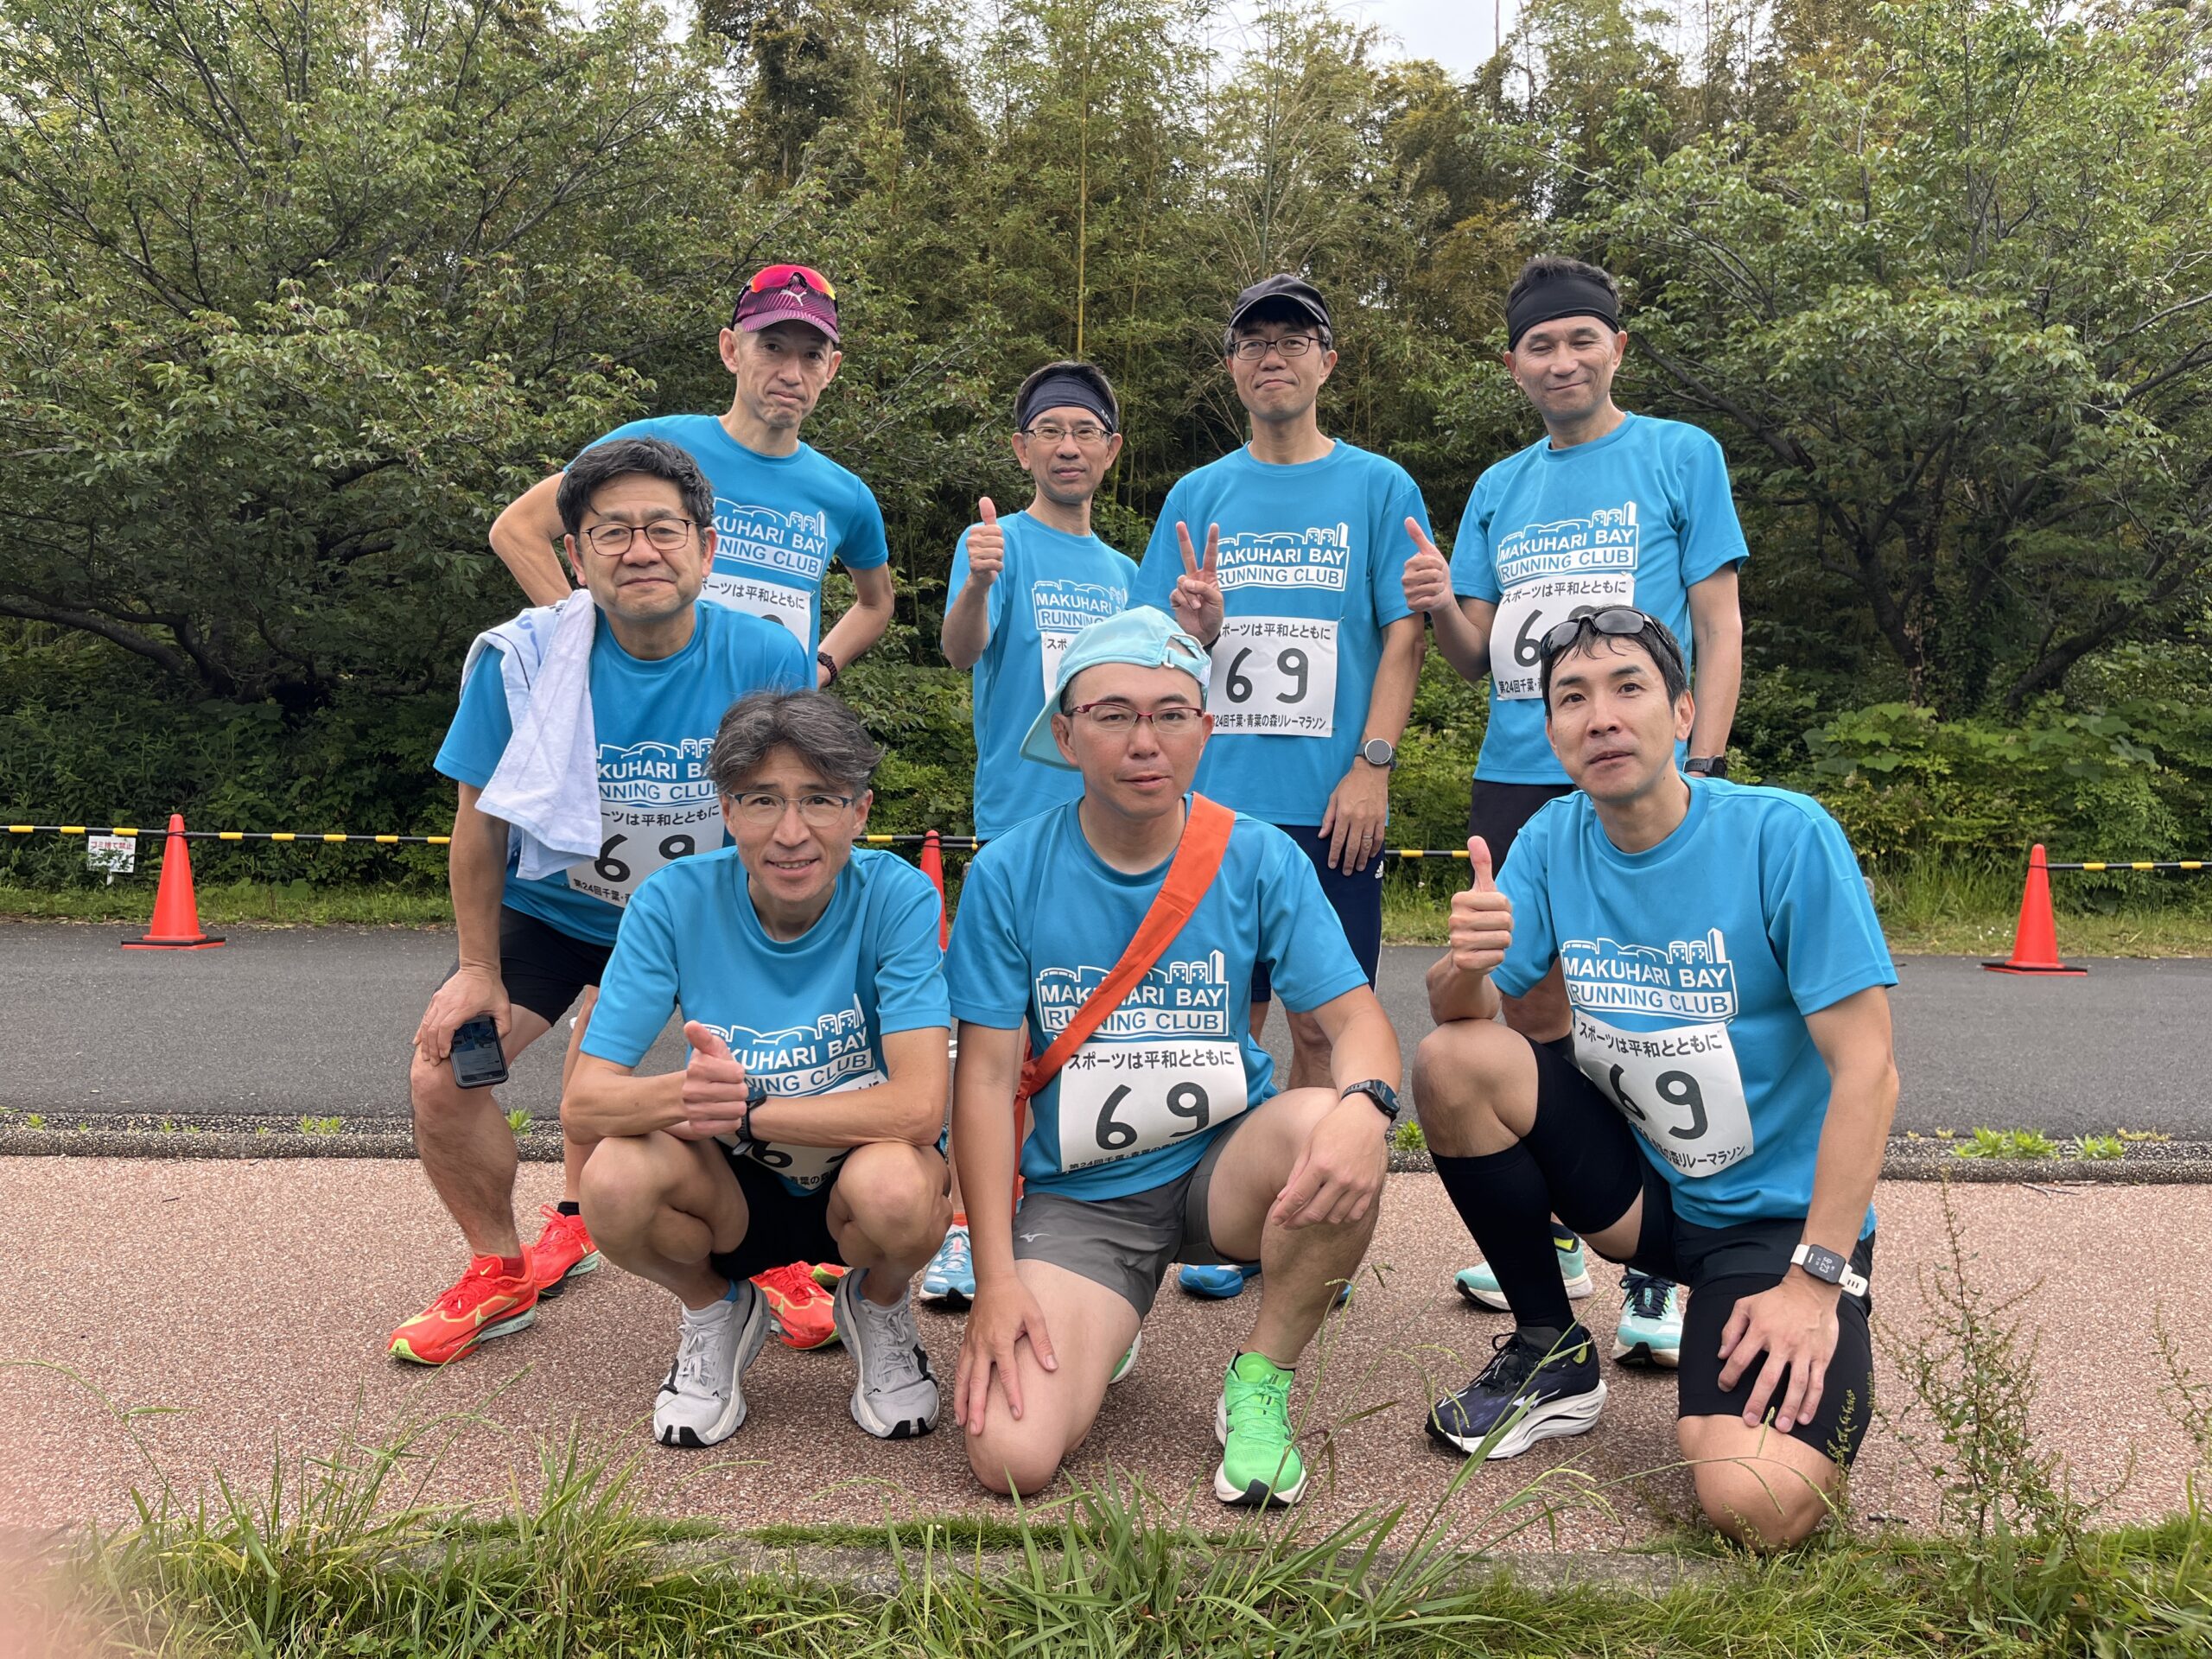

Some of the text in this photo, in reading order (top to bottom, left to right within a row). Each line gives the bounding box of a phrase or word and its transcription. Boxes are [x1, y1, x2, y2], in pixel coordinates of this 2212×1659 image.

[711, 515, 826, 556] KUHARI BAY
[1499, 529, 1634, 562] MAKUHARI BAY
[715, 537, 819, 575] NING CLUB
[1309, 548, 1345, 565] BAY
[1500, 550, 1630, 581] RUNNING CLUB
[1217, 567, 1339, 585] RUNNING CLUB
[702, 579, 804, 610] ーツは平和とともに
[1036, 593, 1112, 615] MAKUHARI
[1502, 580, 1626, 605] スポーツは平和とともに
[1219, 622, 1331, 640] ポーツは平和とともに
[597, 760, 677, 779] KUHARI
[599, 782, 661, 800] NNING
[601, 804, 720, 827] ーツは平和とともに
[1563, 957, 1727, 988] MAKUHARI BAY
[1040, 984, 1224, 1007] MAKARI BAY
[1569, 983, 1728, 1014] RUNNING CLUB
[1048, 1009, 1219, 1031] RUNING CLUB
[729, 1027, 868, 1071] KUHARI BAY
[1580, 1021, 1723, 1058] スポーツは平和とともに
[745, 1074, 800, 1092] NING
[810, 1053, 868, 1086] CLUB
[1068, 1049, 1235, 1071] スポーツは平和とともに
